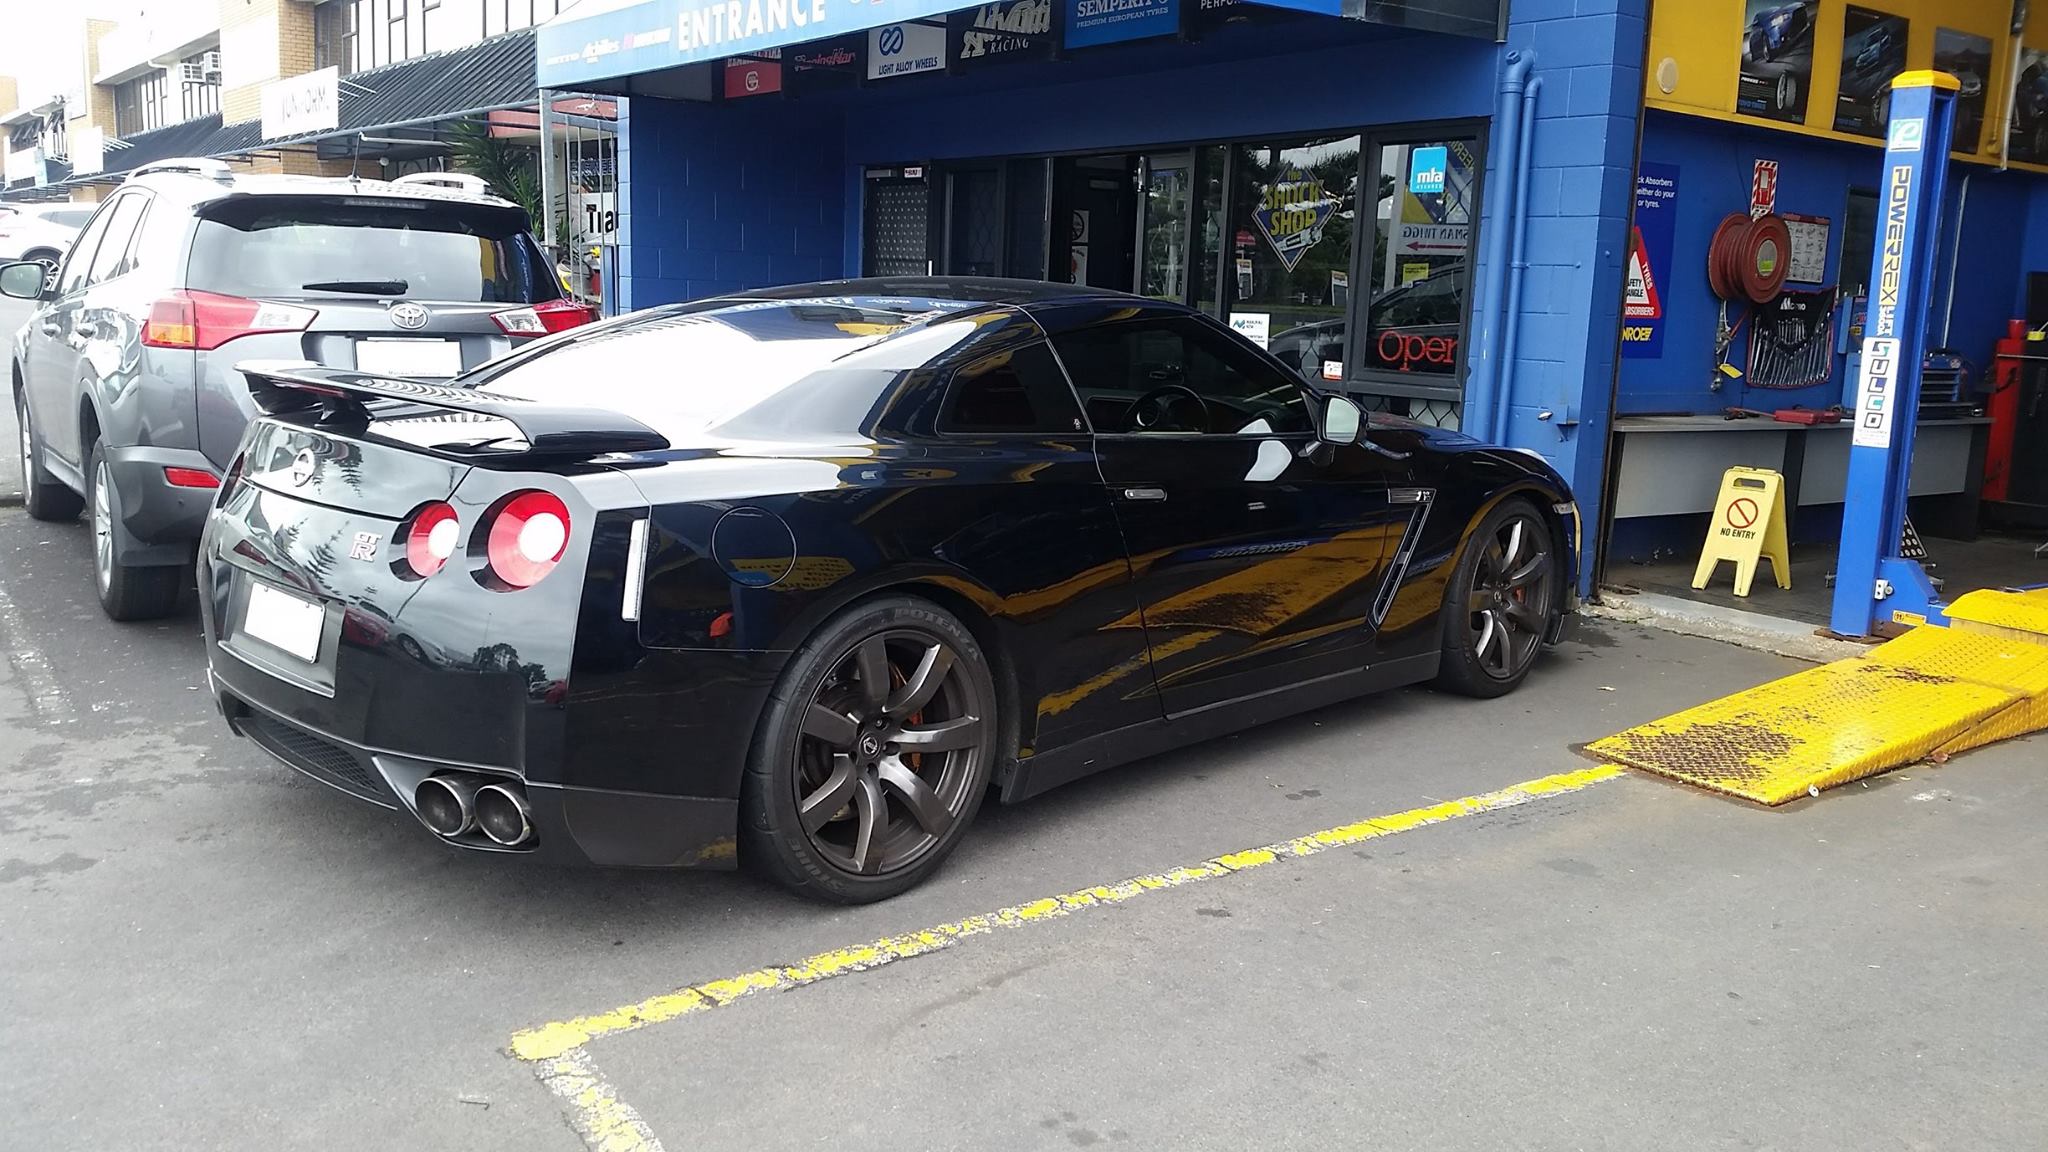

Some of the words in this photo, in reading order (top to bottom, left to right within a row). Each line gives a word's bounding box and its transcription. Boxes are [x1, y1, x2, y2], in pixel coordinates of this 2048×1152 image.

[1200, 0, 1251, 11] PERFO
[677, 0, 827, 50] ENTRANCE
[1076, 18, 1107, 29] PREMIUM
[1108, 11, 1146, 23] EUROPEAN
[1147, 6, 1169, 17] TYRES
[990, 38, 1029, 54] RACING
[878, 63, 894, 75] LIGHT
[895, 60, 913, 73] ALLOY
[915, 56, 938, 70] WHEELS
[1645, 176, 1673, 187] Absorbers
[1264, 181, 1321, 211] SHOCK
[1654, 189, 1661, 197] do
[1662, 190, 1675, 199] your
[1637, 199, 1644, 207] or
[1645, 200, 1660, 209] tyres.
[1270, 209, 1317, 236] SHOP
[1880, 167, 1911, 304] POWERREX
[1628, 279, 1642, 287] FETY
[1627, 289, 1644, 298] ANGLE
[1622, 327, 1653, 341] NROE
[1863, 341, 1892, 429] SULCO
[1720, 527, 1731, 536] NO
[1731, 528, 1756, 539] ENTRY
